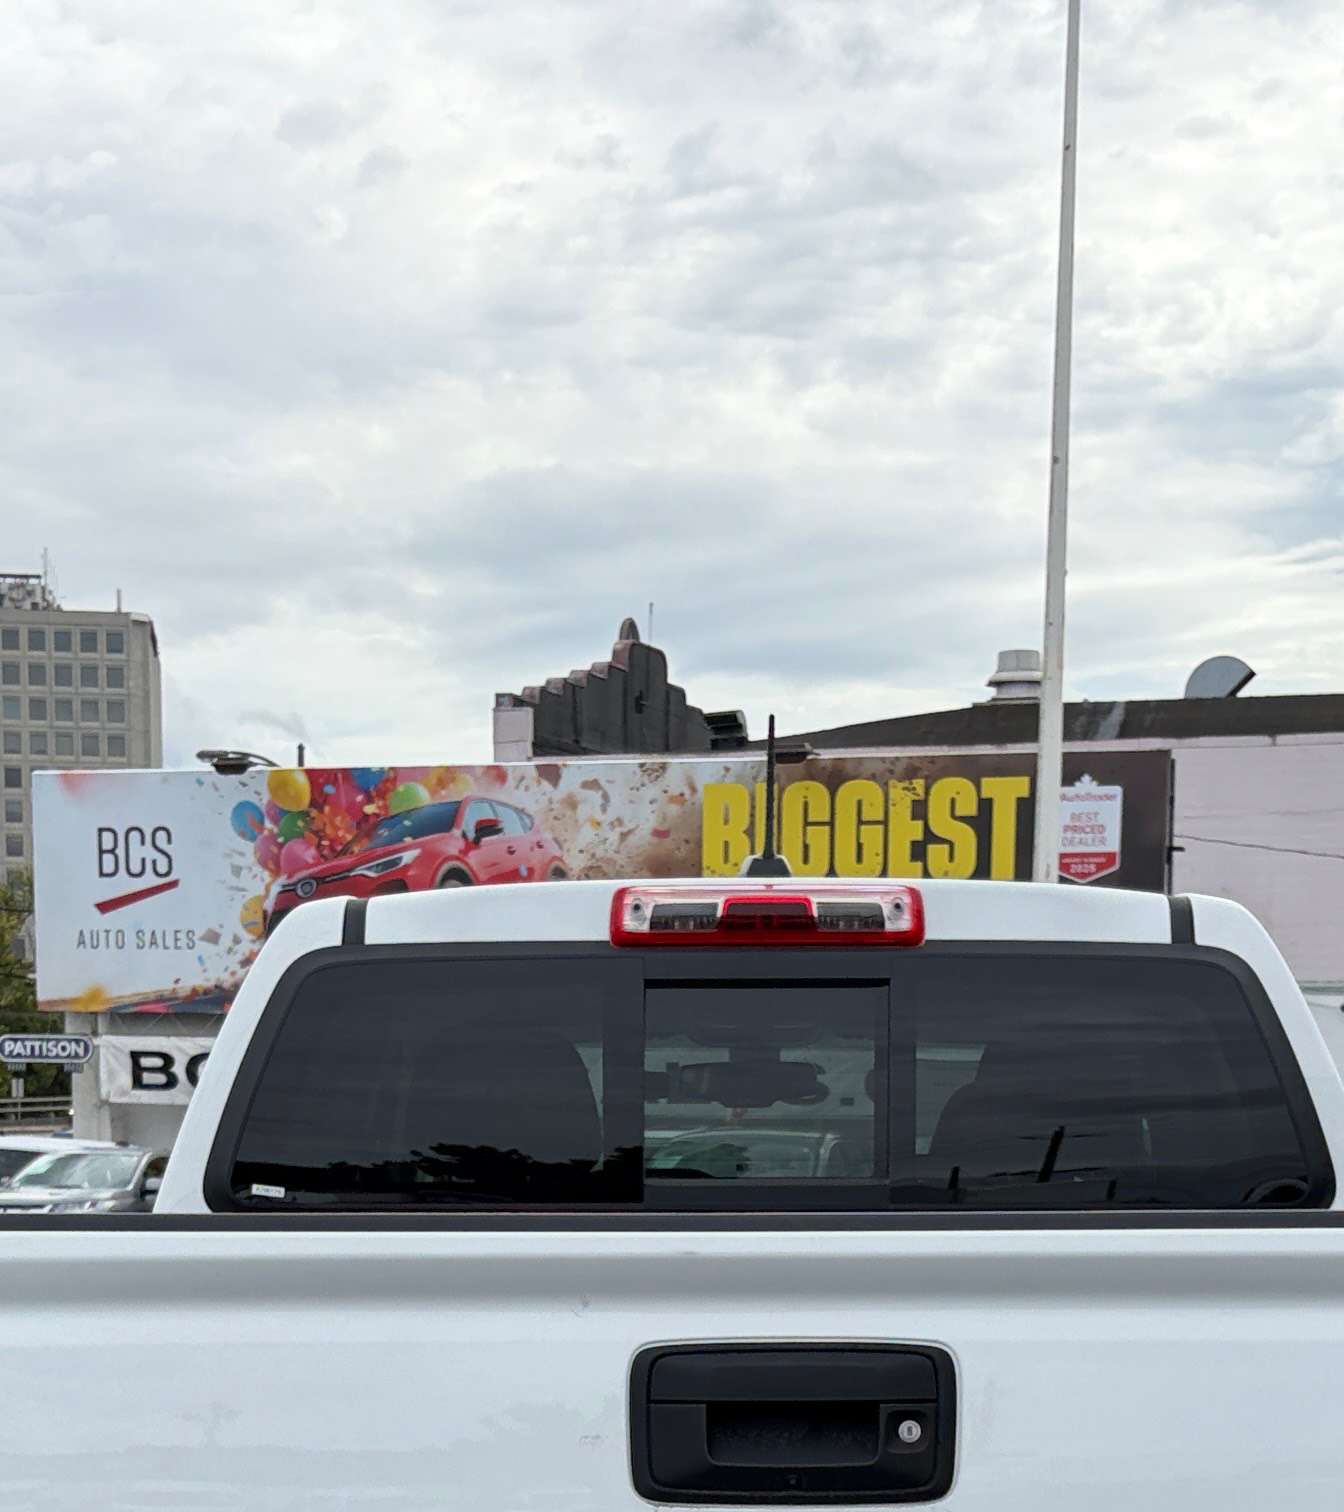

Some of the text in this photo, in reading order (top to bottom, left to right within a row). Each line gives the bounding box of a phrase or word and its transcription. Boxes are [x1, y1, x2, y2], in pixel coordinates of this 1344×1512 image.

[702, 776, 1030, 881] BIGGEST
[97, 826, 173, 878] BCS
[76, 929, 196, 950] AUTO SALES
[5, 1040, 84, 1057] PATTISON
